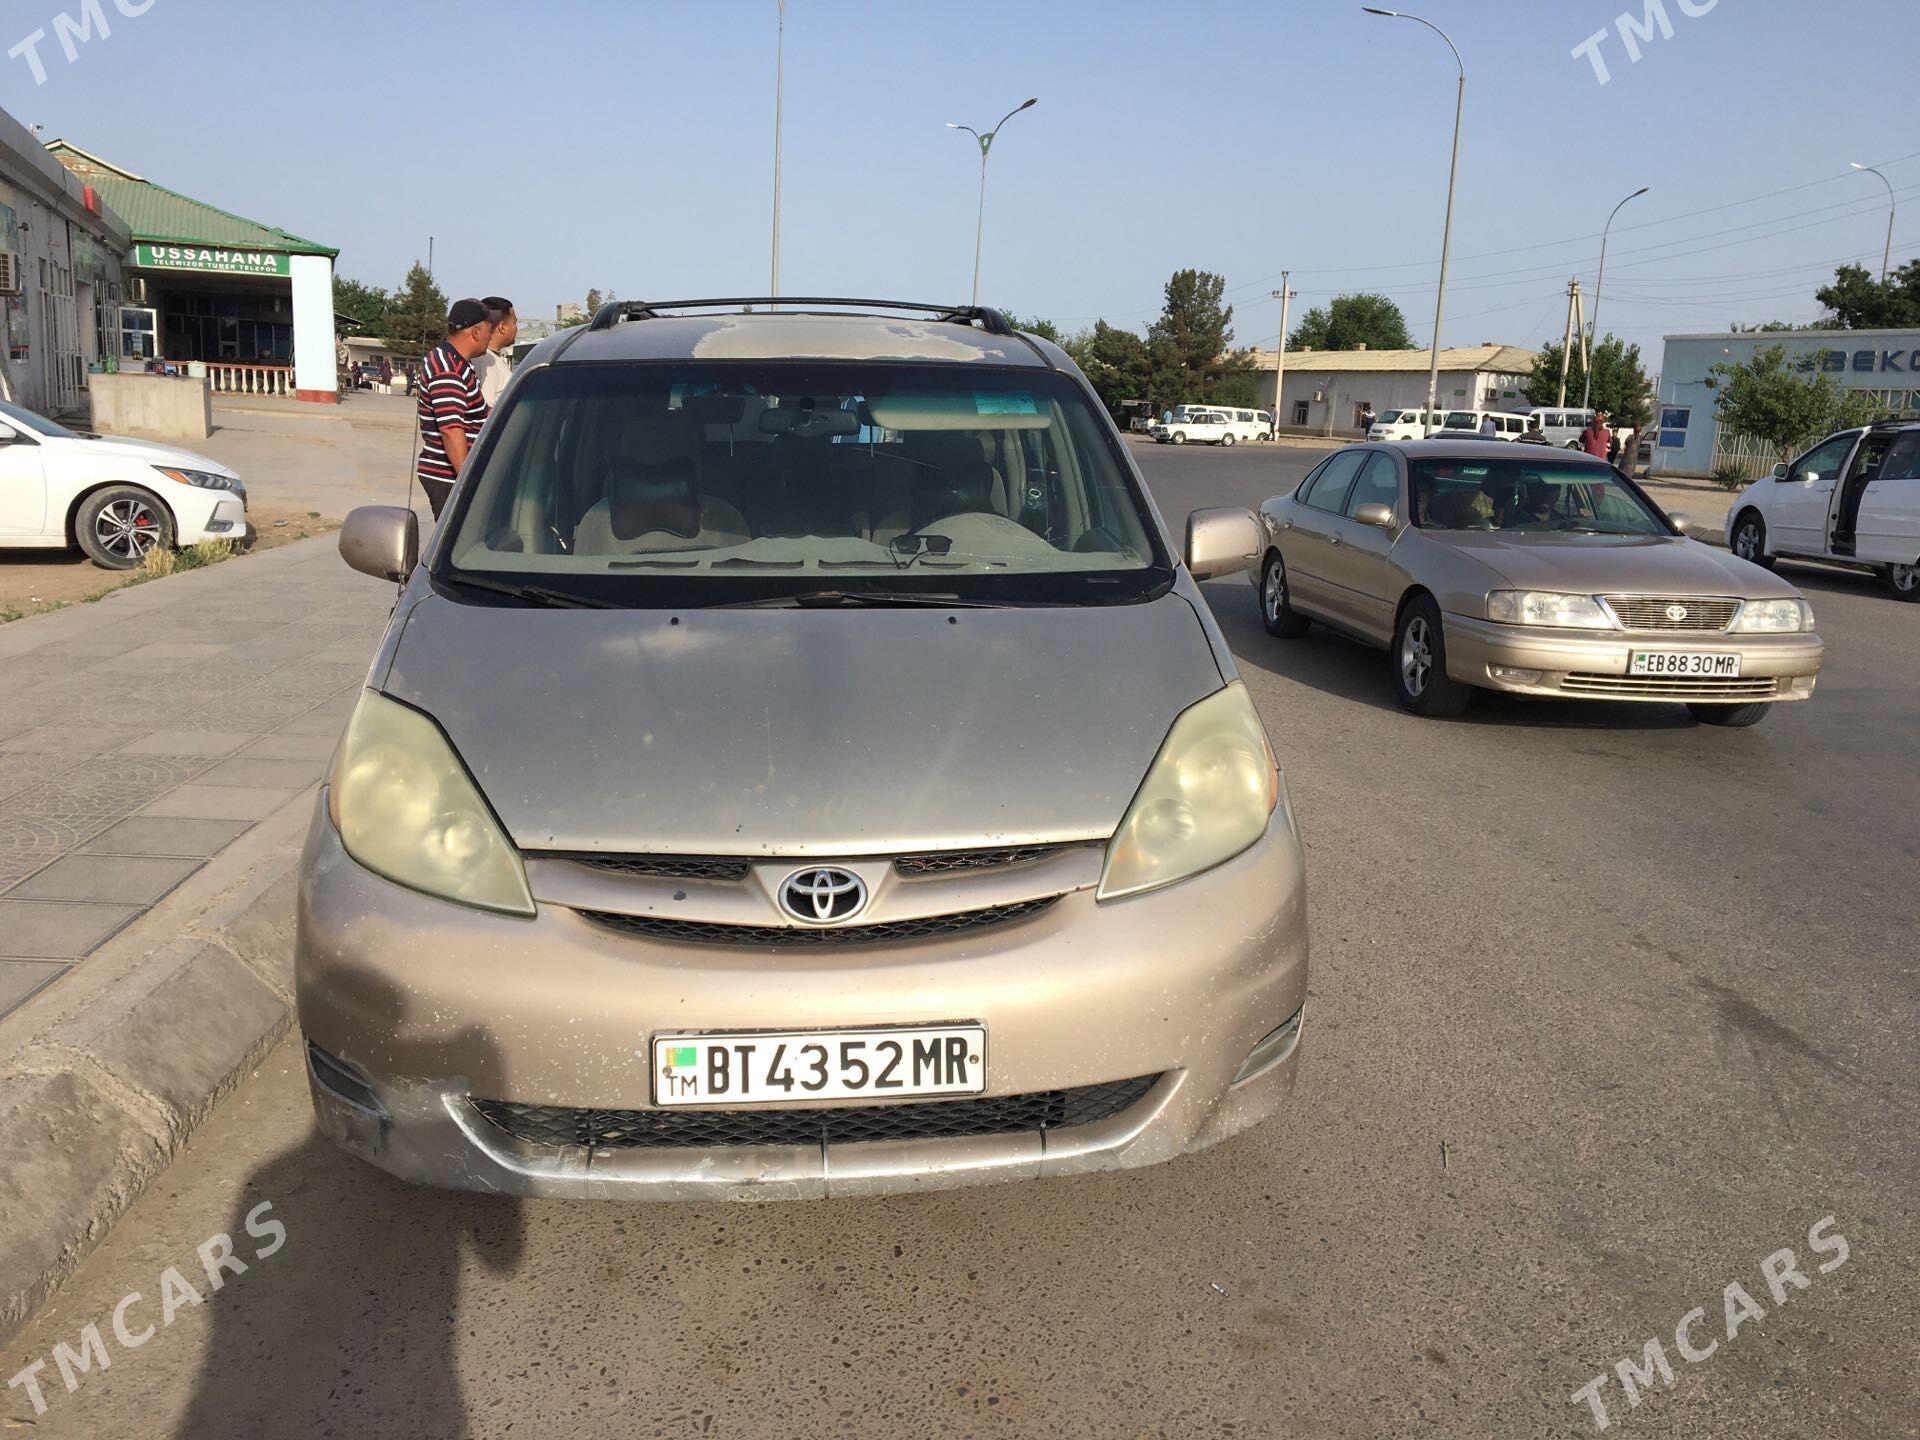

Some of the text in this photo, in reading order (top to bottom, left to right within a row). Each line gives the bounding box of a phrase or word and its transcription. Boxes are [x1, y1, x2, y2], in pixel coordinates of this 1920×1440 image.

[151, 247, 277, 266] USSAHANA
[154, 259, 203, 267] TELEWIZOR
[666, 1074, 698, 1097] TM
